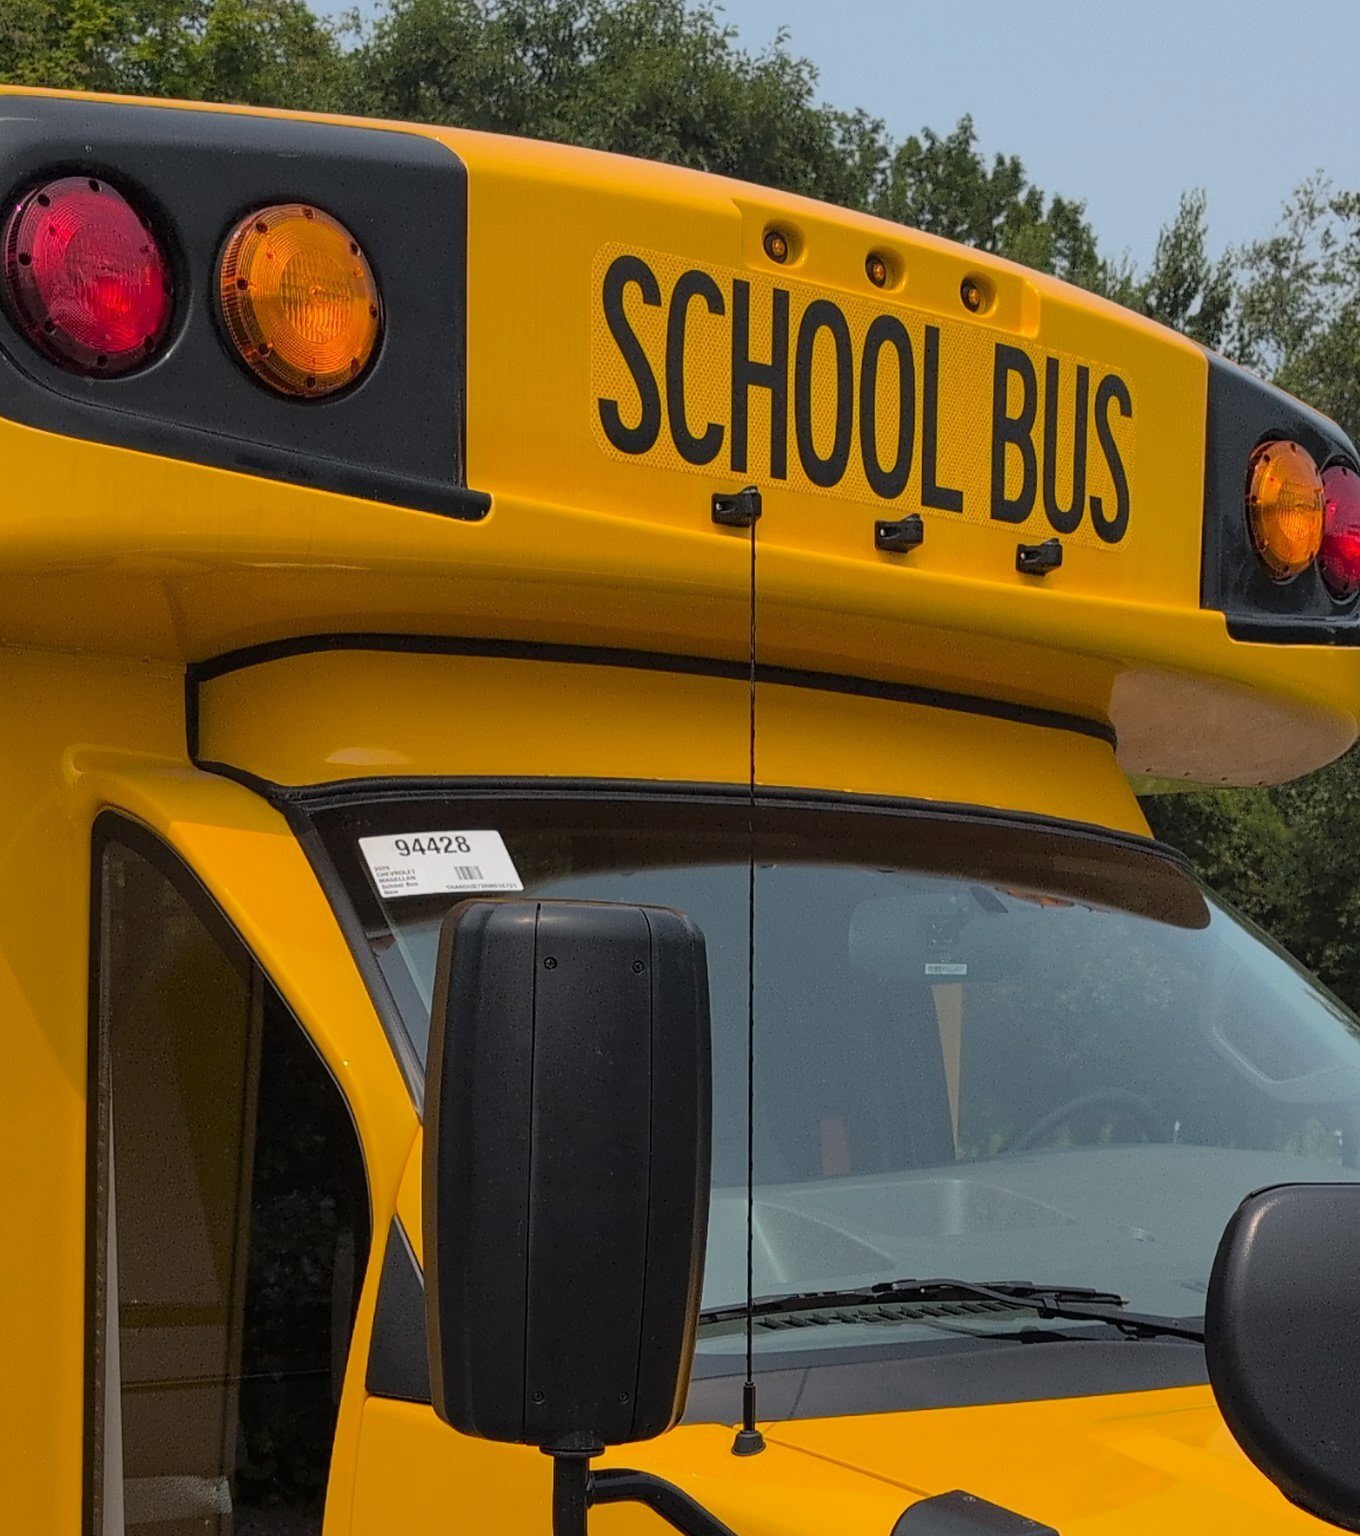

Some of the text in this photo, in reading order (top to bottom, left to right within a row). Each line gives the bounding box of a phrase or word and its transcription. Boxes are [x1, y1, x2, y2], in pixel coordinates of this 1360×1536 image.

[597, 254, 1133, 545] SCHOOL BUS
[394, 836, 471, 857] 94428
